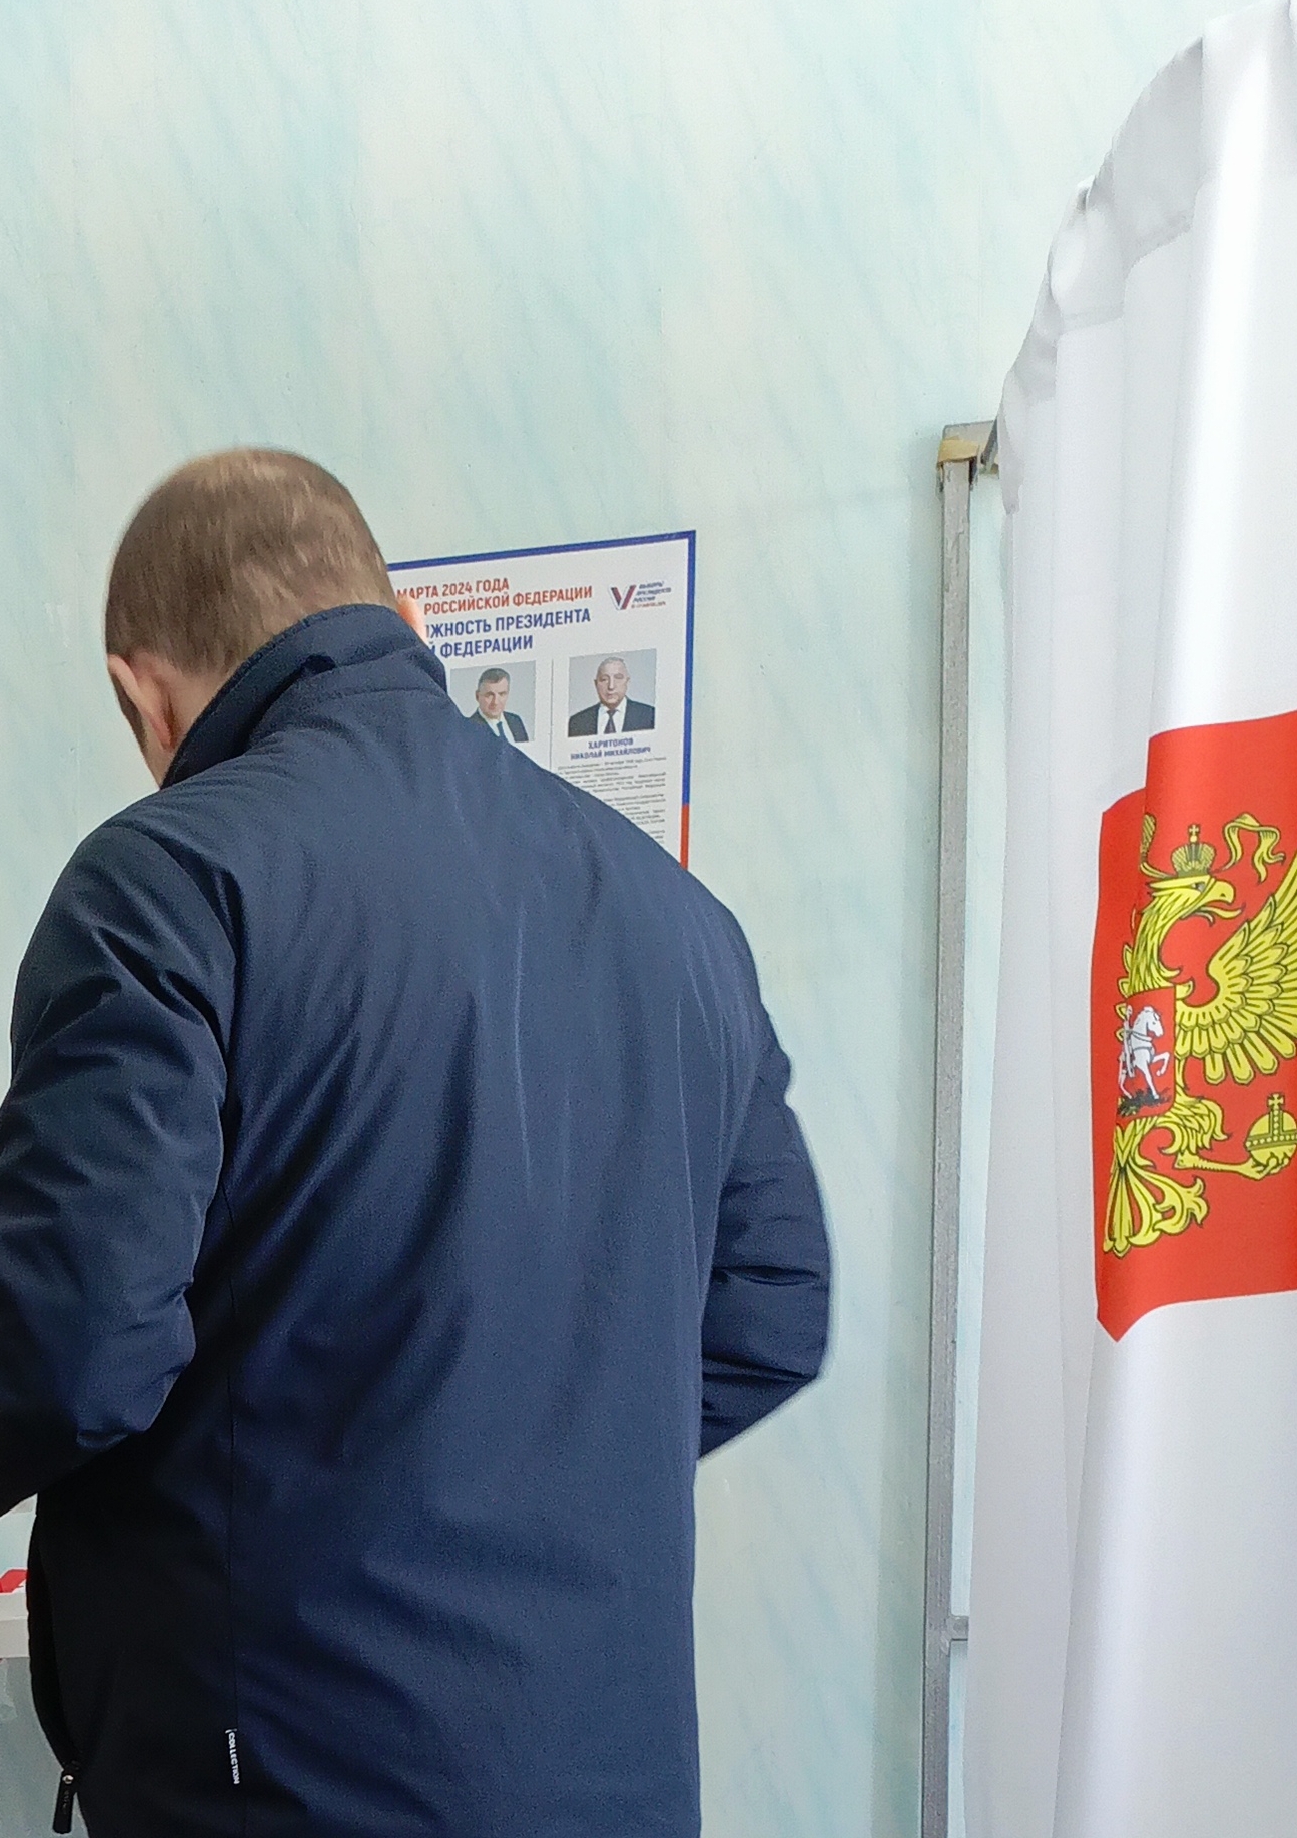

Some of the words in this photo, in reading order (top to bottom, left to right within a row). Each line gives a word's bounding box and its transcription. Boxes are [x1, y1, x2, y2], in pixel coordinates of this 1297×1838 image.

[442, 580, 473, 597] 2024
[476, 577, 510, 593] ГОДА
[423, 590, 510, 616] РОССИЙСКОЙ
[513, 585, 593, 607] ФЕДЕРАЦИИ
[496, 607, 591, 632] ПРЕЗИДЕНТА
[440, 635, 534, 659] ФЕДЕРАЦИИ
